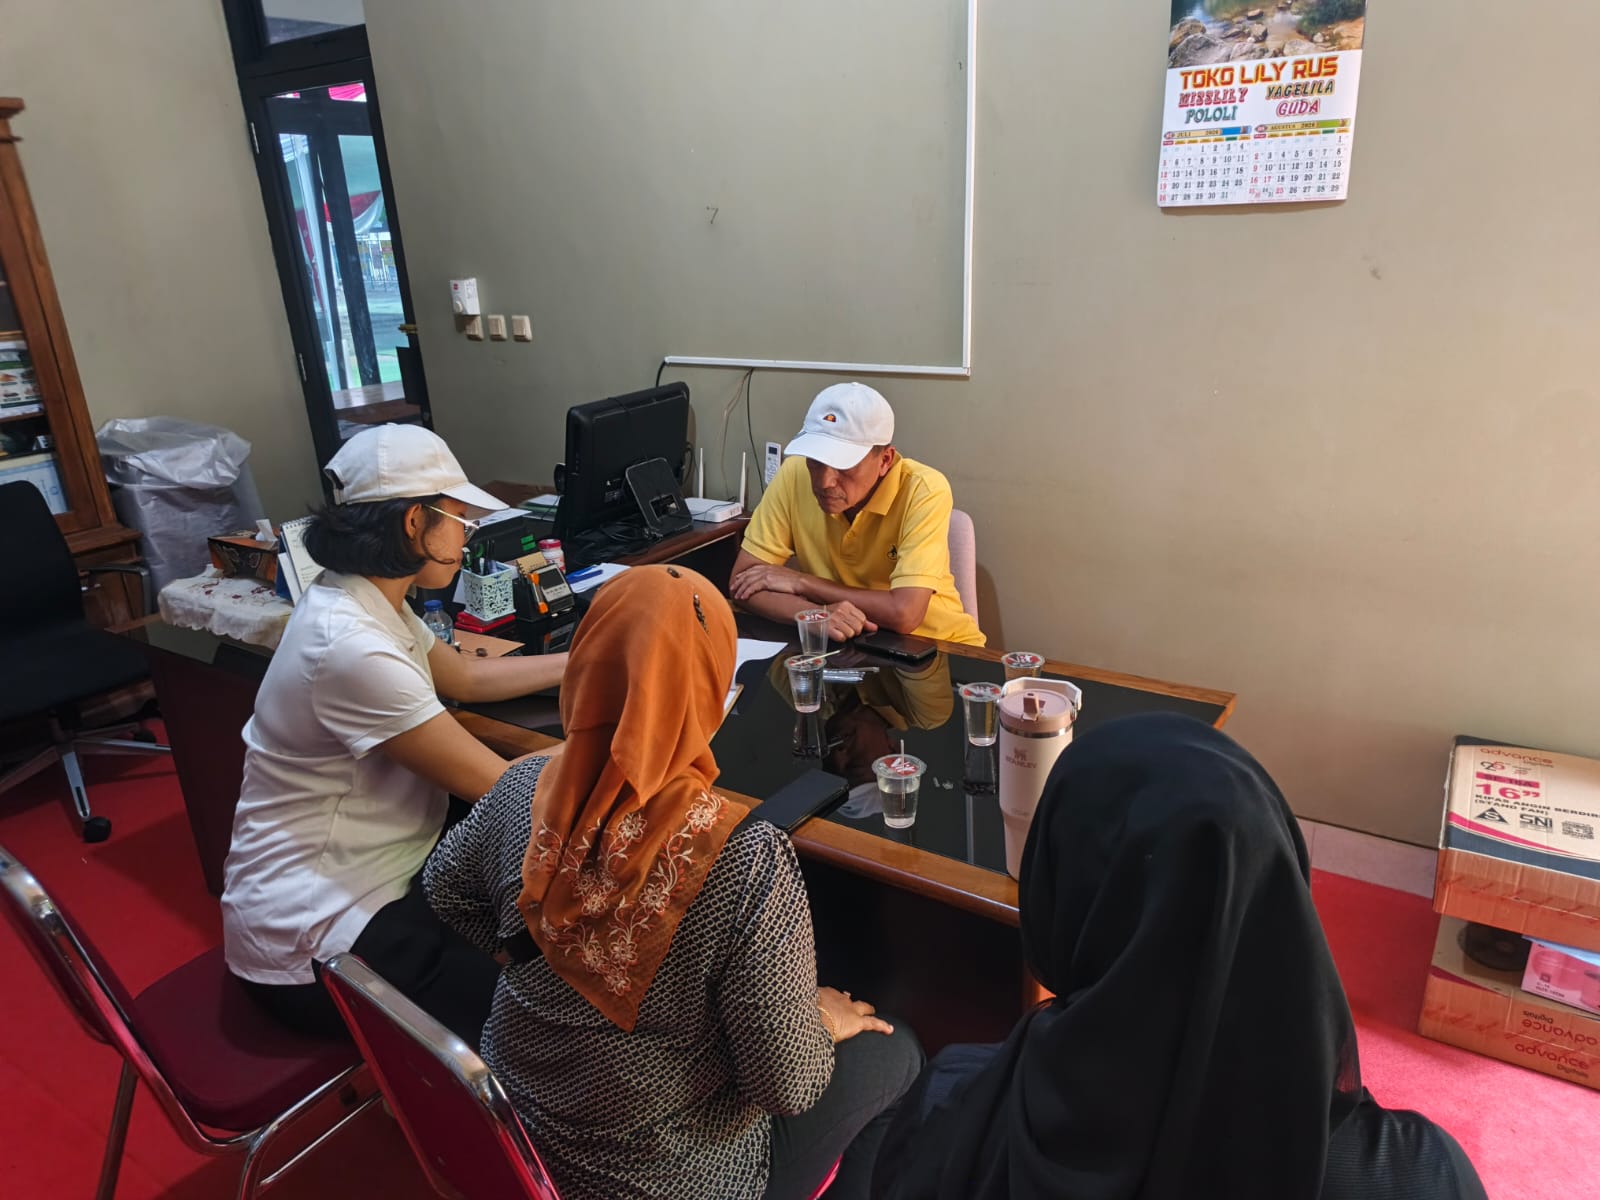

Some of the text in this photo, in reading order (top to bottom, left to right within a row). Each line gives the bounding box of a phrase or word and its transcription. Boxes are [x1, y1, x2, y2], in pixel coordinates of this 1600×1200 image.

[1180, 55, 1338, 89] TOKO LILY RUS
[1178, 88, 1248, 107] MISSLILY
[1266, 80, 1335, 100] YAGELILA
[1185, 106, 1238, 123] POLOLI
[1276, 99, 1320, 117] GUDA
[1480, 748, 1553, 764] advance
[1475, 794, 1509, 803] KIPAS
[1513, 801, 1551, 810] ANGIN
[1475, 799, 1549, 816] (STAND FAN)
[1520, 814, 1553, 828] SNI
[1522, 1018, 1598, 1045] advance
[1515, 1043, 1590, 1069] advance
